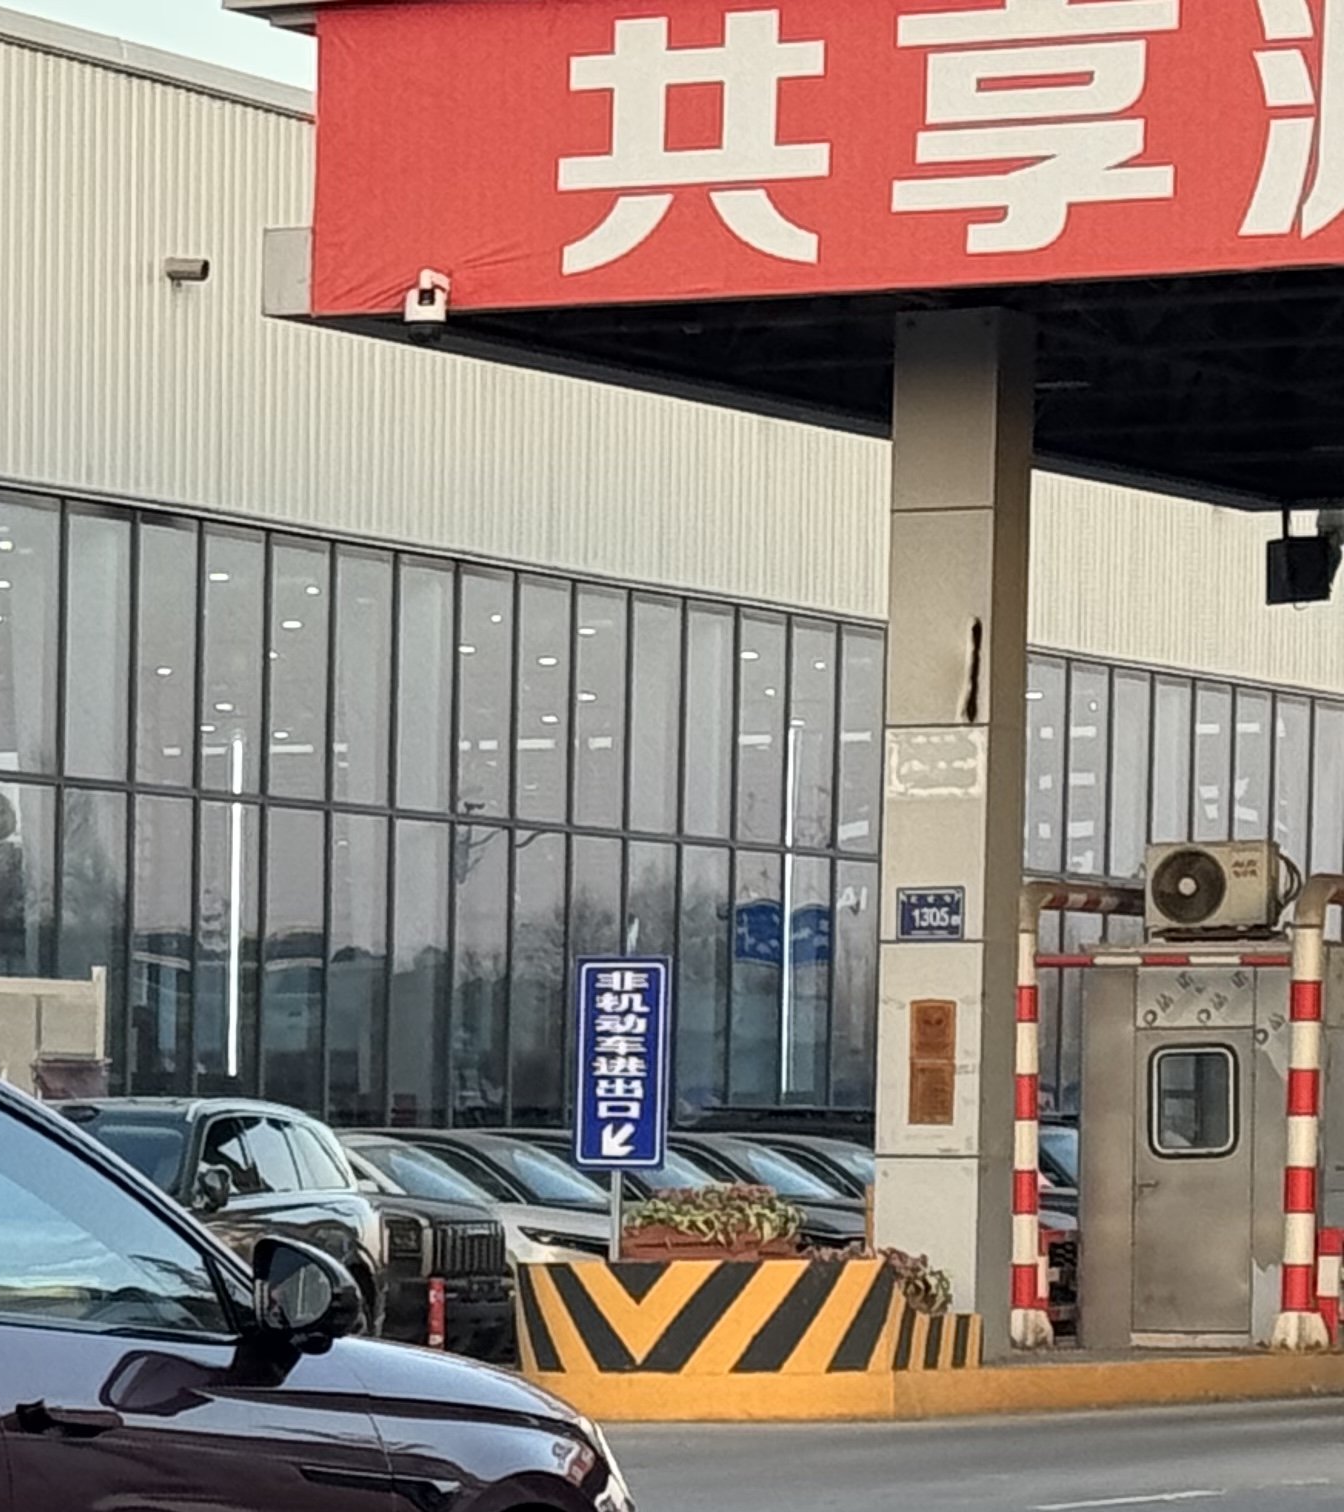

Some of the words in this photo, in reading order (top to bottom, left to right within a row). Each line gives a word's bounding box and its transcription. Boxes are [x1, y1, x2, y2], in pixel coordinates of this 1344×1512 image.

[592, 971, 650, 1118] 非机动车进出口
